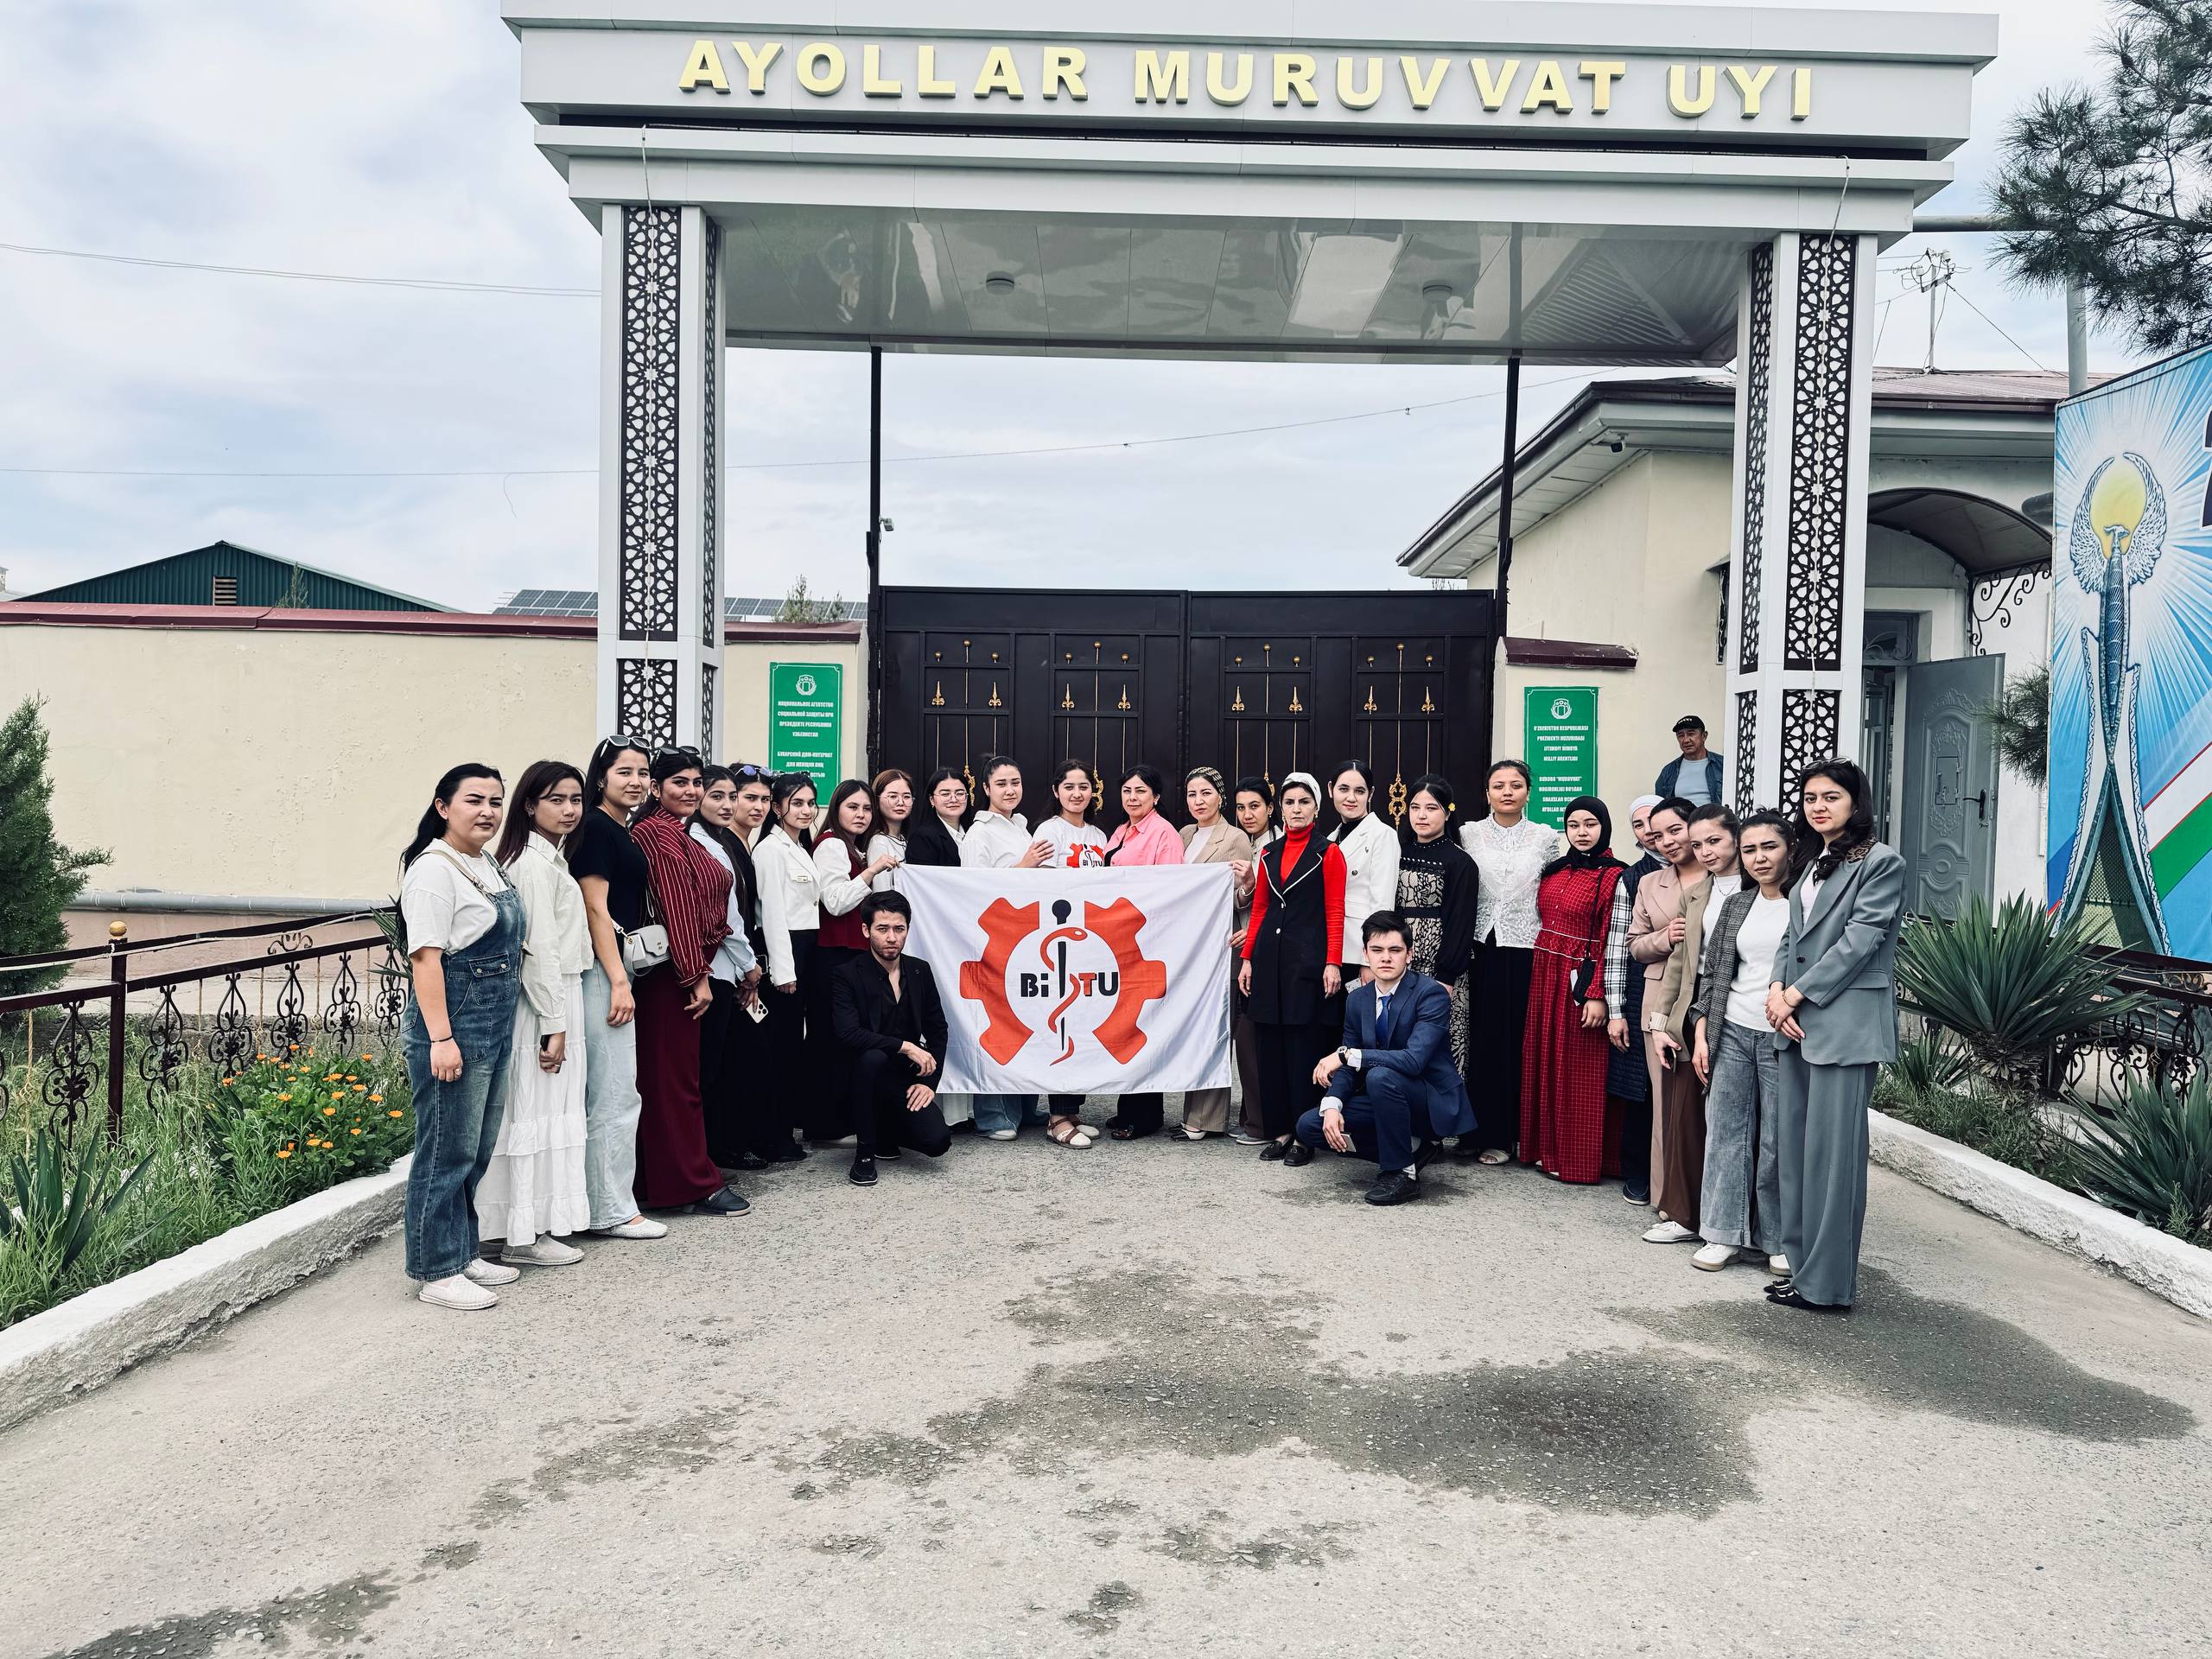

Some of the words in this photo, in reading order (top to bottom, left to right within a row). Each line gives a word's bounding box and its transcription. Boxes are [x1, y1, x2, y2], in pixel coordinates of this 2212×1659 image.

[678, 40, 1088, 101] AYOLLAR
[1135, 50, 1625, 115] MURUVVAT
[1666, 65, 1811, 120] UYI
